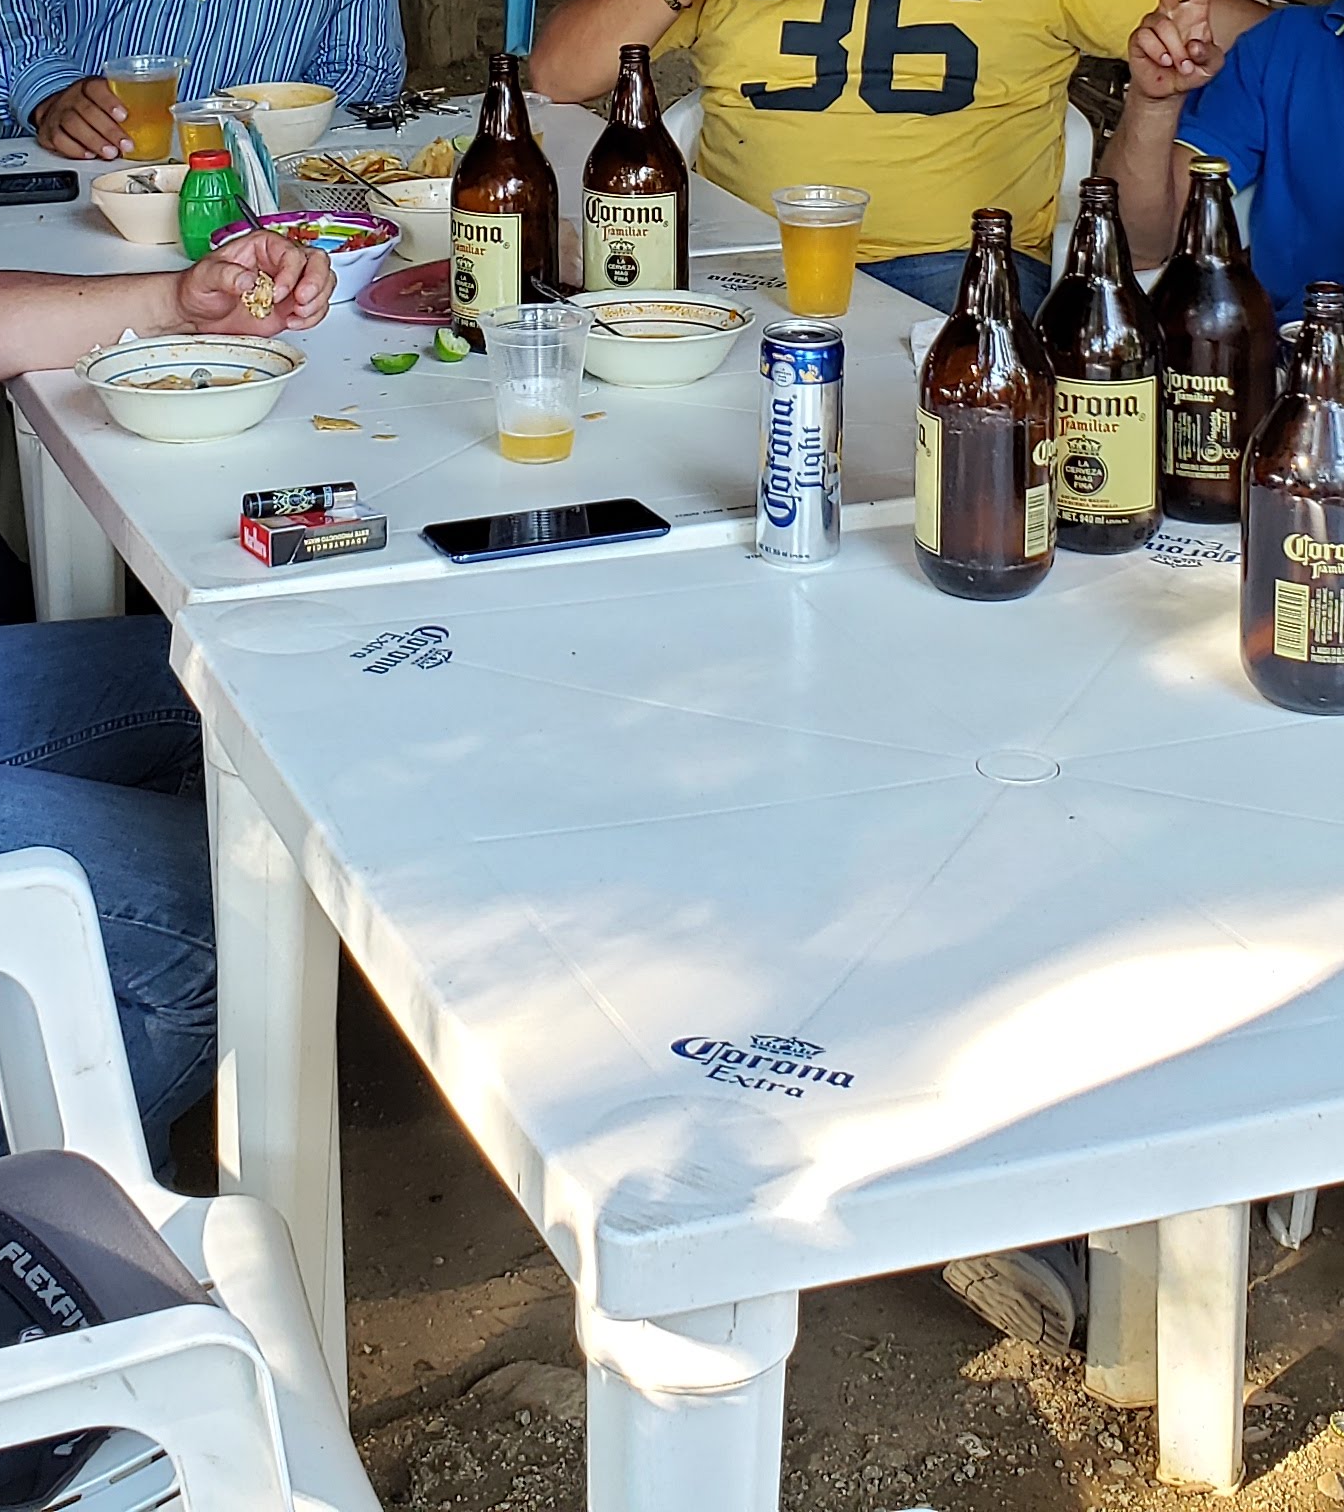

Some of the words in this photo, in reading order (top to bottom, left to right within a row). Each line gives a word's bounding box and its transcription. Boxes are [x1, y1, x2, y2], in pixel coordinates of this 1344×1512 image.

[585, 196, 663, 228] Corona
[601, 224, 649, 242] Familiar
[1058, 414, 1120, 436] Familiar
[763, 397, 802, 528] Corona
[795, 425, 827, 489] Light
[1077, 459, 1090, 468] LA
[306, 537, 368, 553] ADVERTENCIA
[350, 632, 406, 659] Extra
[362, 625, 450, 674] Corona
[670, 1036, 855, 1089] Corona
[705, 1063, 805, 1098] Extra
